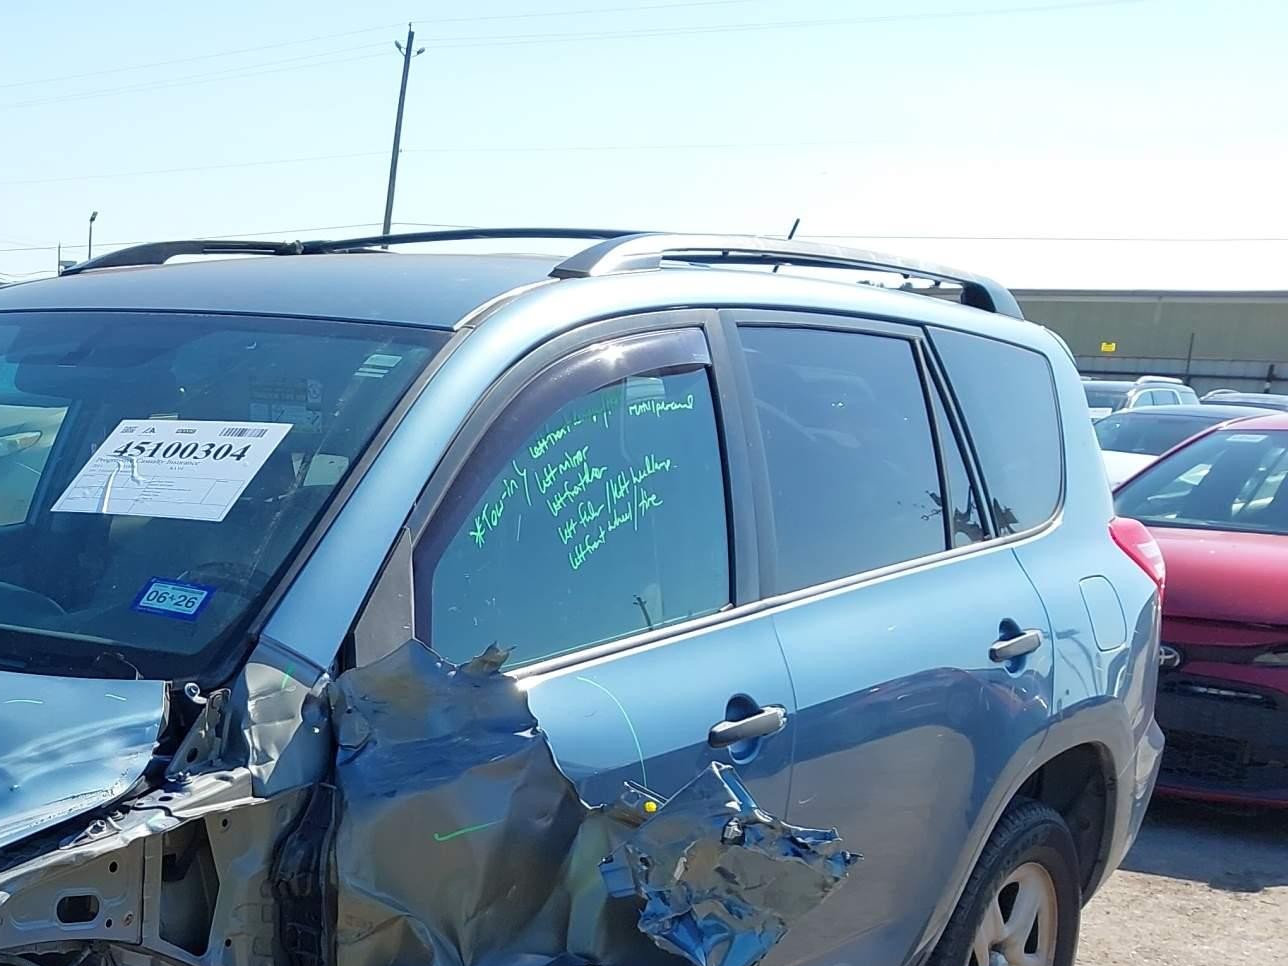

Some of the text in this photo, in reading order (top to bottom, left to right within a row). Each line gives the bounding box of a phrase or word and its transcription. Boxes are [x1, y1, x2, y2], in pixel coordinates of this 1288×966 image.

[111, 440, 252, 462] 45100304
[146, 590, 198, 608] 06 26
